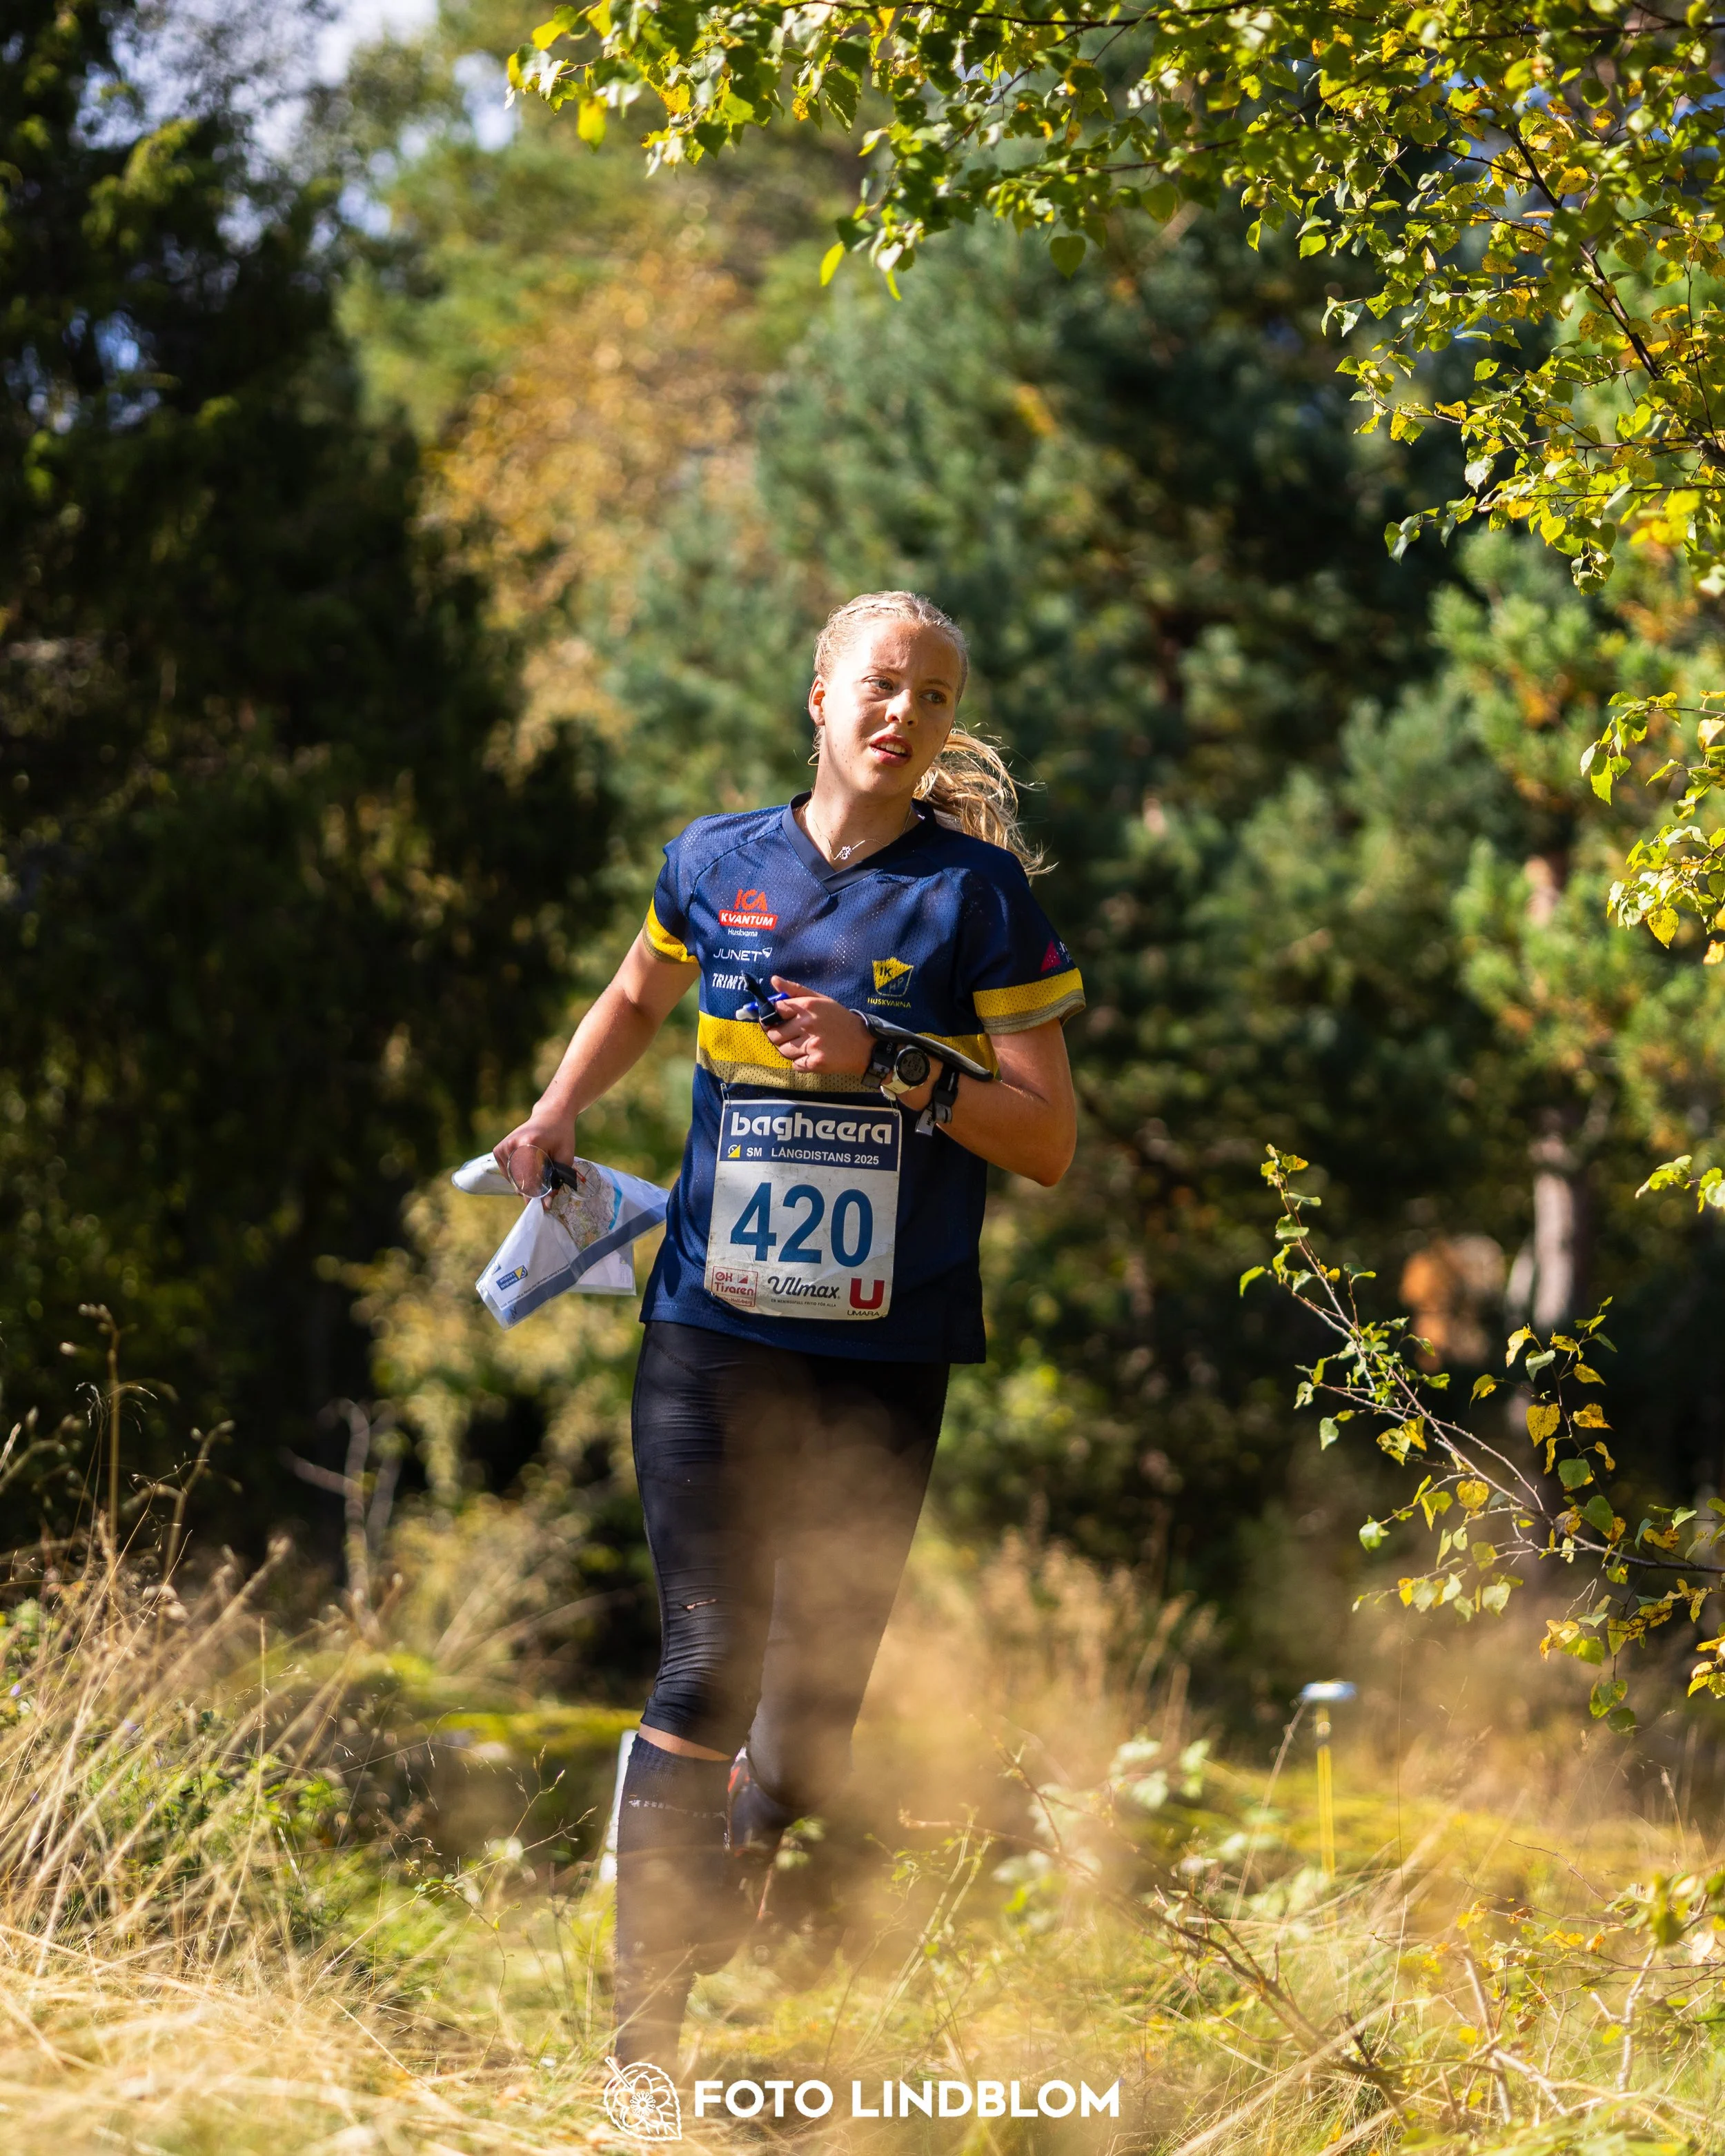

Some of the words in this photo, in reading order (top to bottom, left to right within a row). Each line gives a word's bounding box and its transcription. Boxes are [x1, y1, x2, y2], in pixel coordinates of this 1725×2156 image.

[733, 889, 767, 911] ICA
[721, 912, 773, 927] KVANTUM
[728, 928, 758, 937] Huskvarna
[713, 948, 762, 962] JUNET
[880, 967, 892, 977] IK
[867, 997, 911, 1008] HUSKVARNA
[730, 1111, 892, 1144] bagheera
[747, 1147, 762, 1157] SM
[771, 1147, 851, 1163] LÅNGDISTANS
[854, 1154, 879, 1165] 2025
[730, 1182, 873, 1267] 420
[715, 1282, 754, 1296] Tisaren
[767, 1276, 840, 1299] Ullmax
